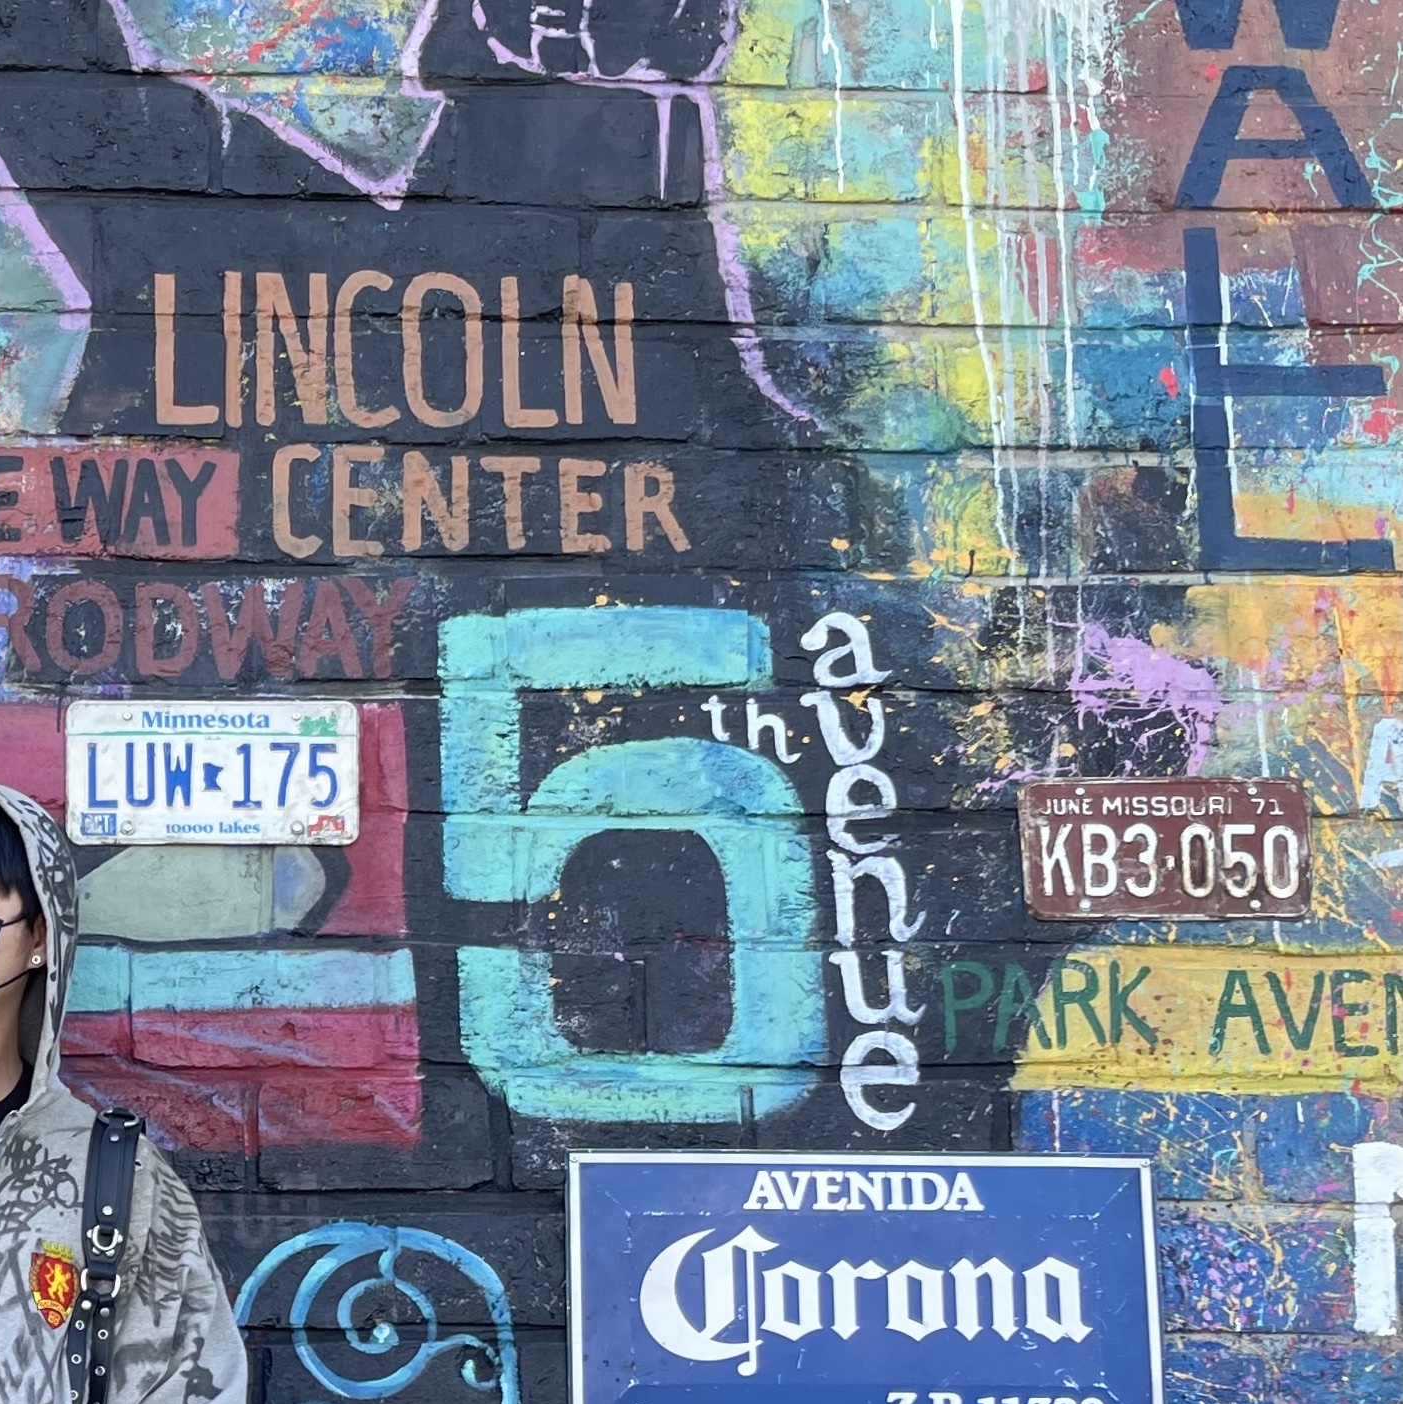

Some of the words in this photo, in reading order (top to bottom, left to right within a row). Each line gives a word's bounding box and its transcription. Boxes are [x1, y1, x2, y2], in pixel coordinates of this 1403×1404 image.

[153, 269, 637, 430] LINCOLN
[49, 452, 221, 547] WAY
[272, 443, 692, 559] CENTER
[141, 711, 270, 729] Minnesota
[165, 823, 214, 834] 10000
[219, 822, 261, 834] lakes
[1041, 797, 1093, 815] JUNE
[1102, 796, 1232, 815] MISSOURI
[1249, 799, 1284, 815] 71
[799, 611, 927, 1131] avenue
[941, 959, 1159, 1054] PARK
[743, 1170, 985, 1212] AVENIDA
[639, 1225, 1094, 1377] Corona
